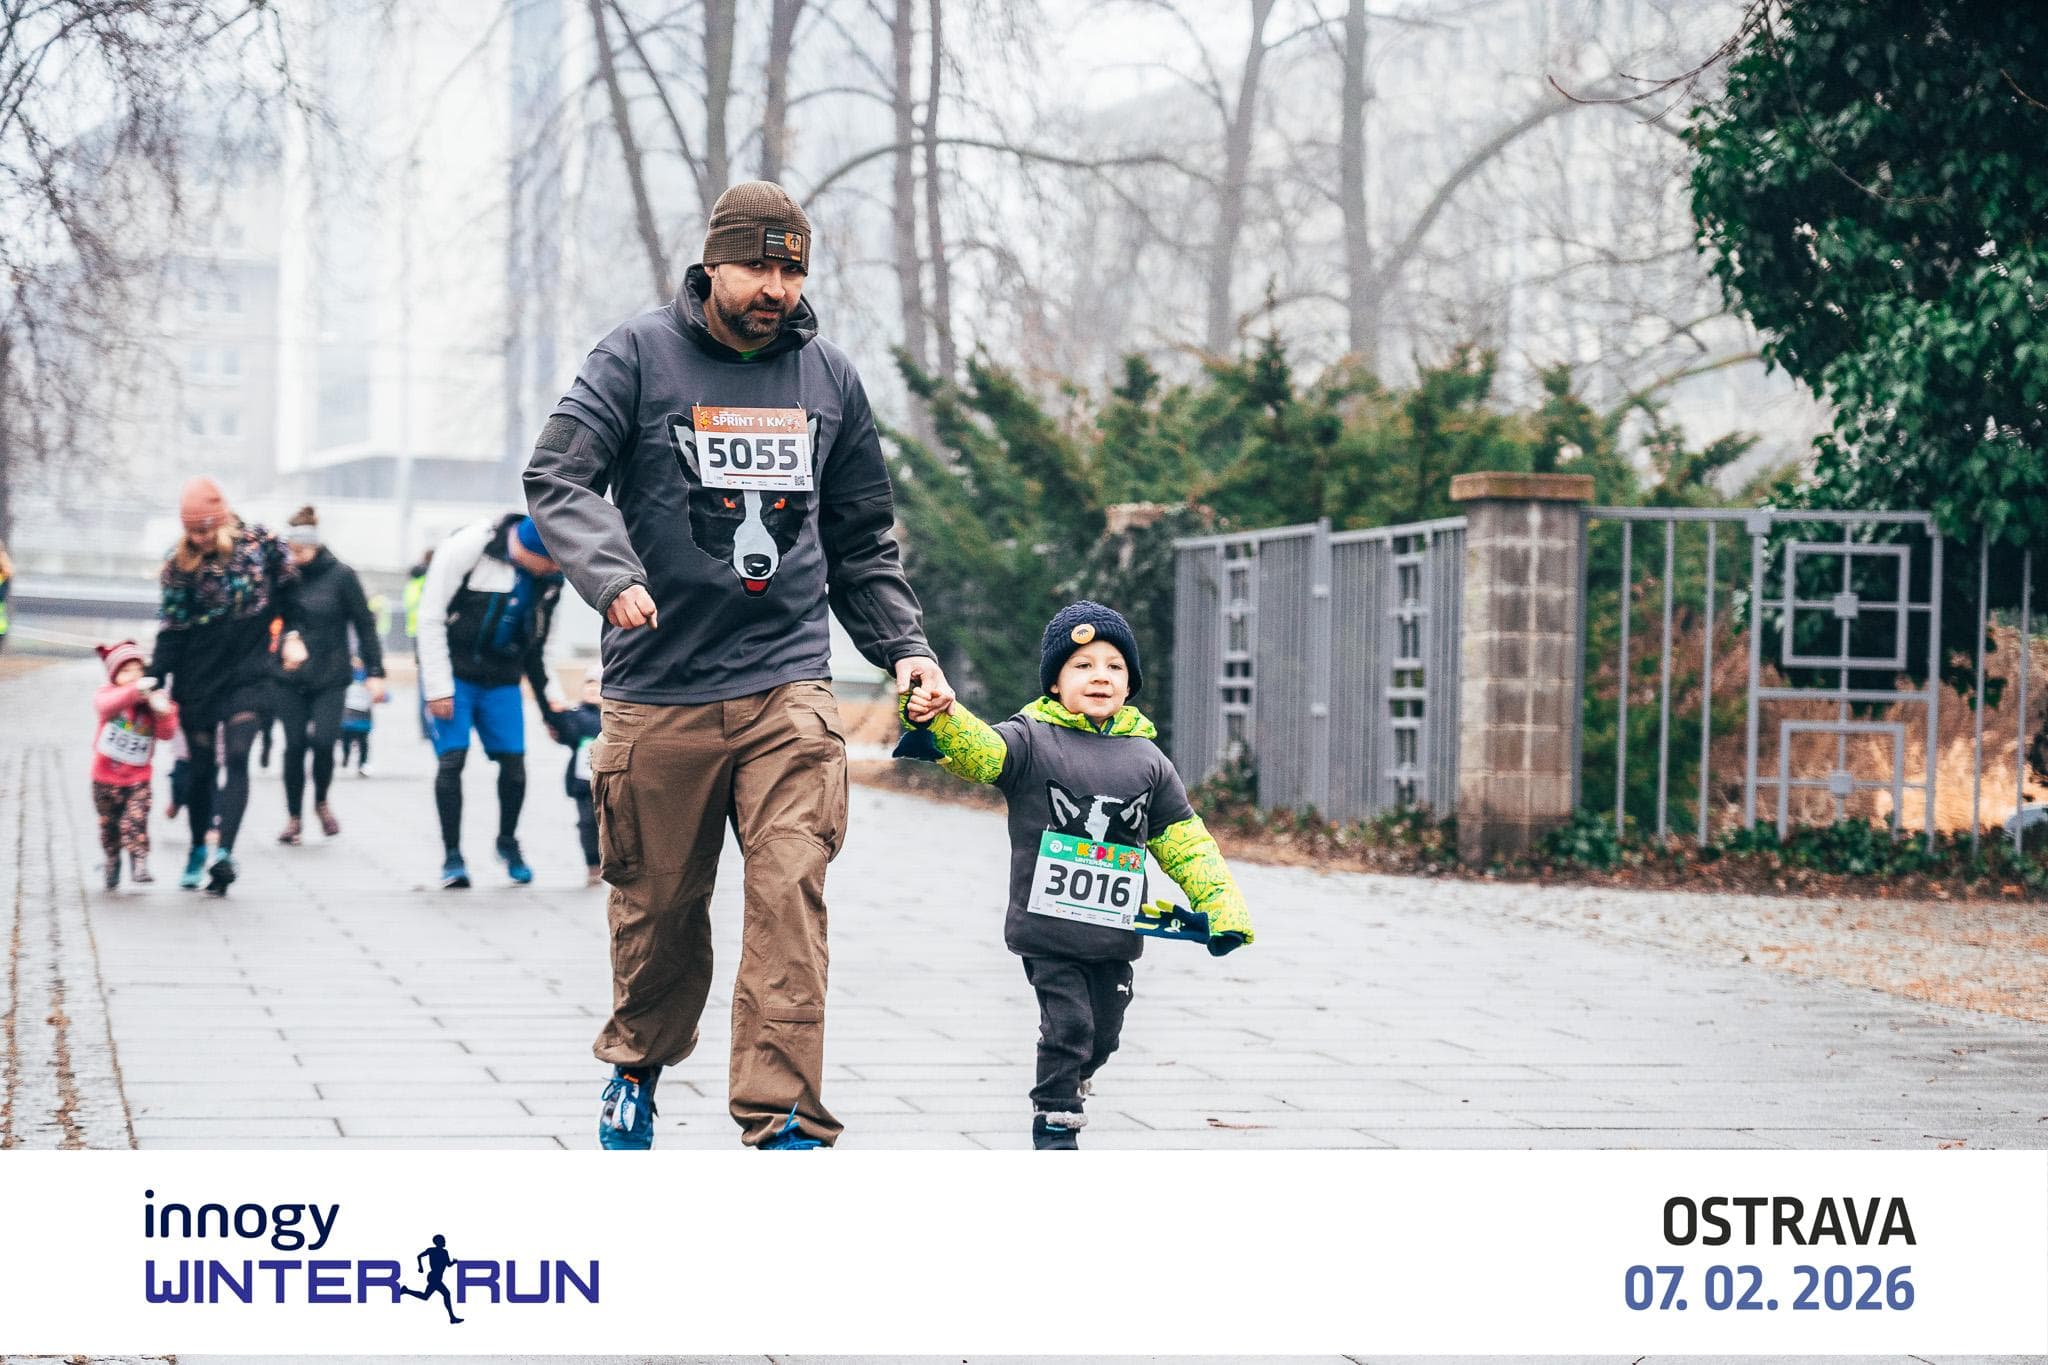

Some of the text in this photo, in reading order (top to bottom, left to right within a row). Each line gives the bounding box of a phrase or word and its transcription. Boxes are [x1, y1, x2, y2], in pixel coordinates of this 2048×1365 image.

[712, 415, 786, 427] SPRINT 1 KM
[708, 437, 799, 471] 5055
[1044, 863, 1132, 907] 3016
